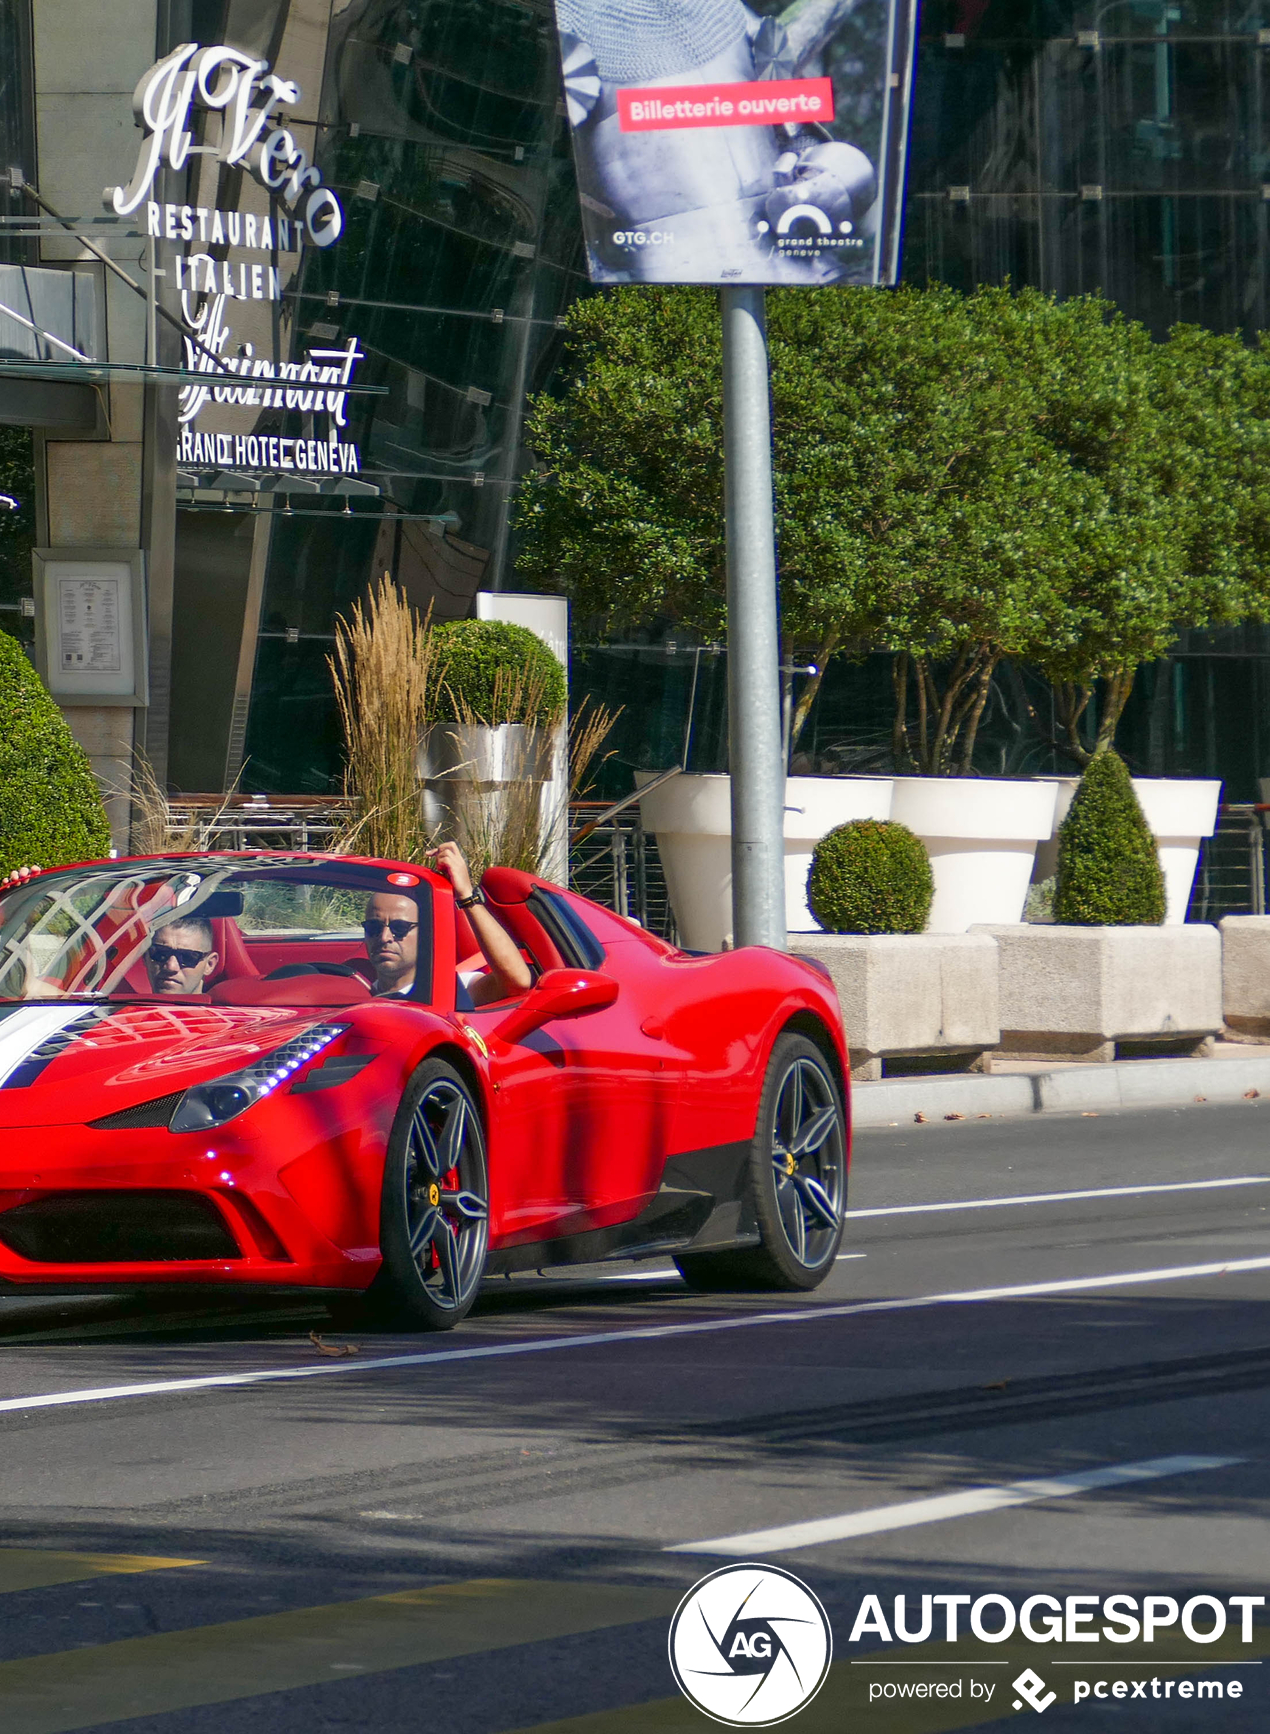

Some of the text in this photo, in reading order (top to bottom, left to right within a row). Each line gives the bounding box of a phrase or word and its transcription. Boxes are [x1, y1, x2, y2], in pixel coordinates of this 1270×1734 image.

[630, 94, 821, 121] Billetterie ouverte
[198, 45, 345, 247] Vero
[148, 201, 304, 250] RESTAURANT
[612, 231, 674, 245] GTG.CH
[778, 237, 813, 247] grand
[176, 254, 279, 300] ITALIEN
[236, 435, 294, 469] HOTEL
[296, 440, 358, 472] GENEVA
